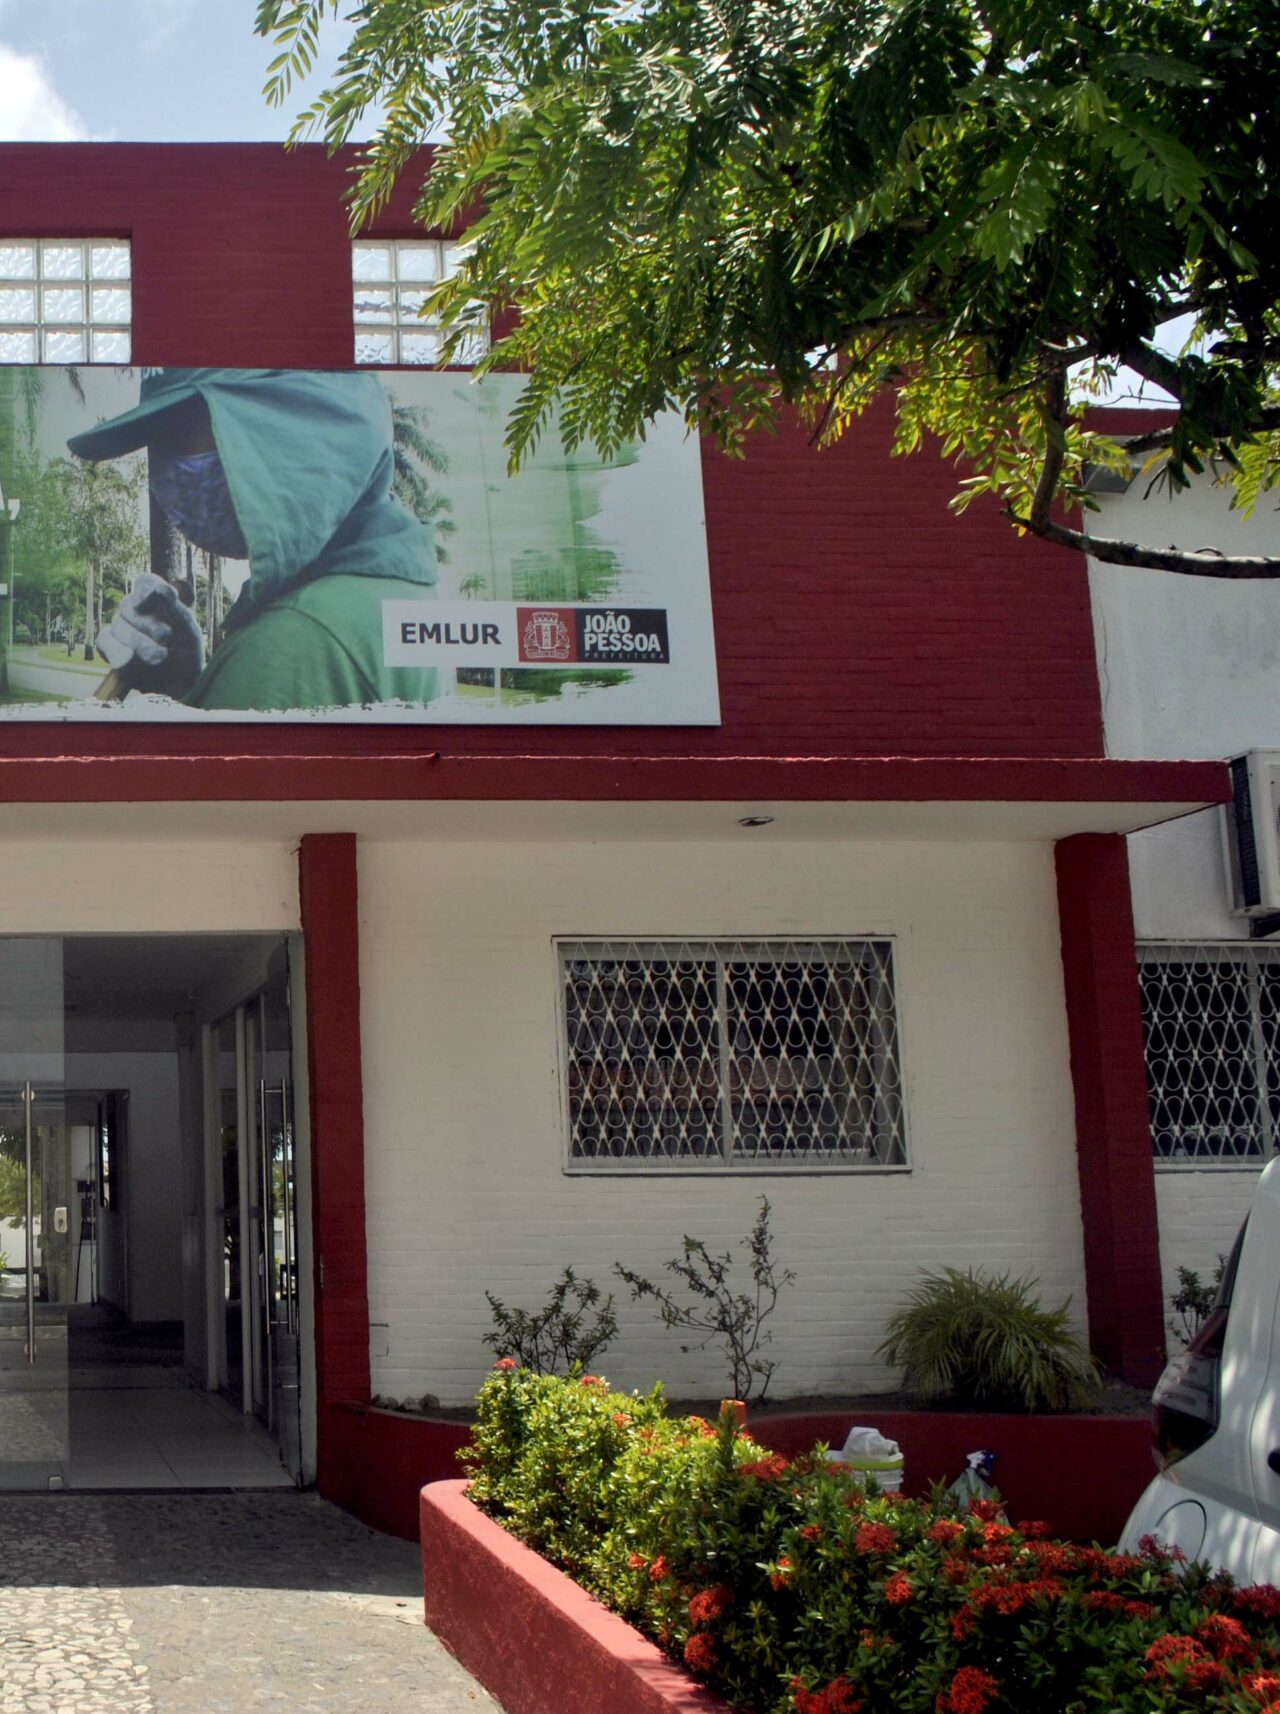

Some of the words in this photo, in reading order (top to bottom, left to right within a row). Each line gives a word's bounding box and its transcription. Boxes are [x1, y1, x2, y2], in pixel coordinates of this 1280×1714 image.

[583, 610, 631, 633] JOÃO
[401, 623, 502, 645] EMLUR
[584, 633, 661, 652] PESSOA
[584, 652, 665, 660] PREFEITURA
